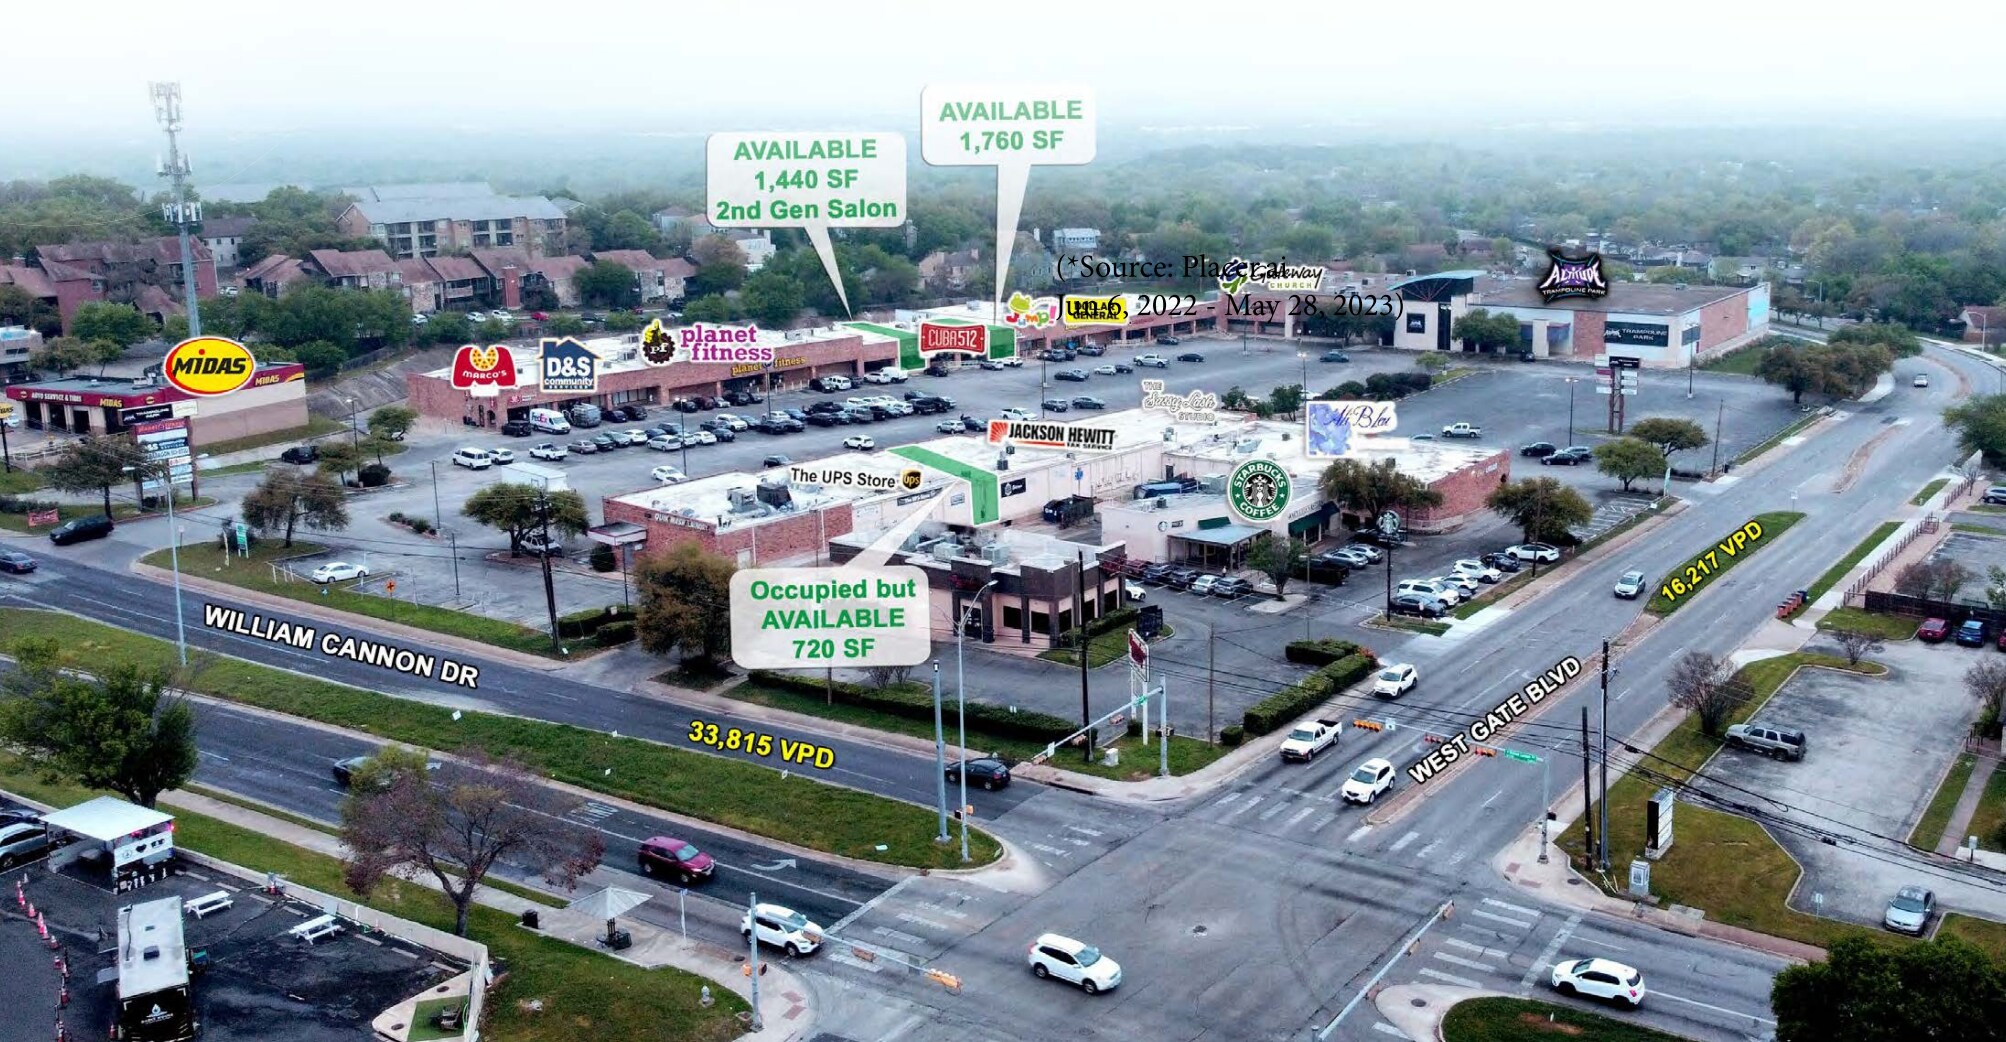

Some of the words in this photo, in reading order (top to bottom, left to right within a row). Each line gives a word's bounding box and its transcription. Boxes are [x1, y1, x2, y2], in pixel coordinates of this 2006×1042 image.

[731, 363, 763, 376] planet
[774, 356, 806, 368] fitness
[255, 374, 280, 386] MIDAS
[100, 398, 123, 408] MIDAS
